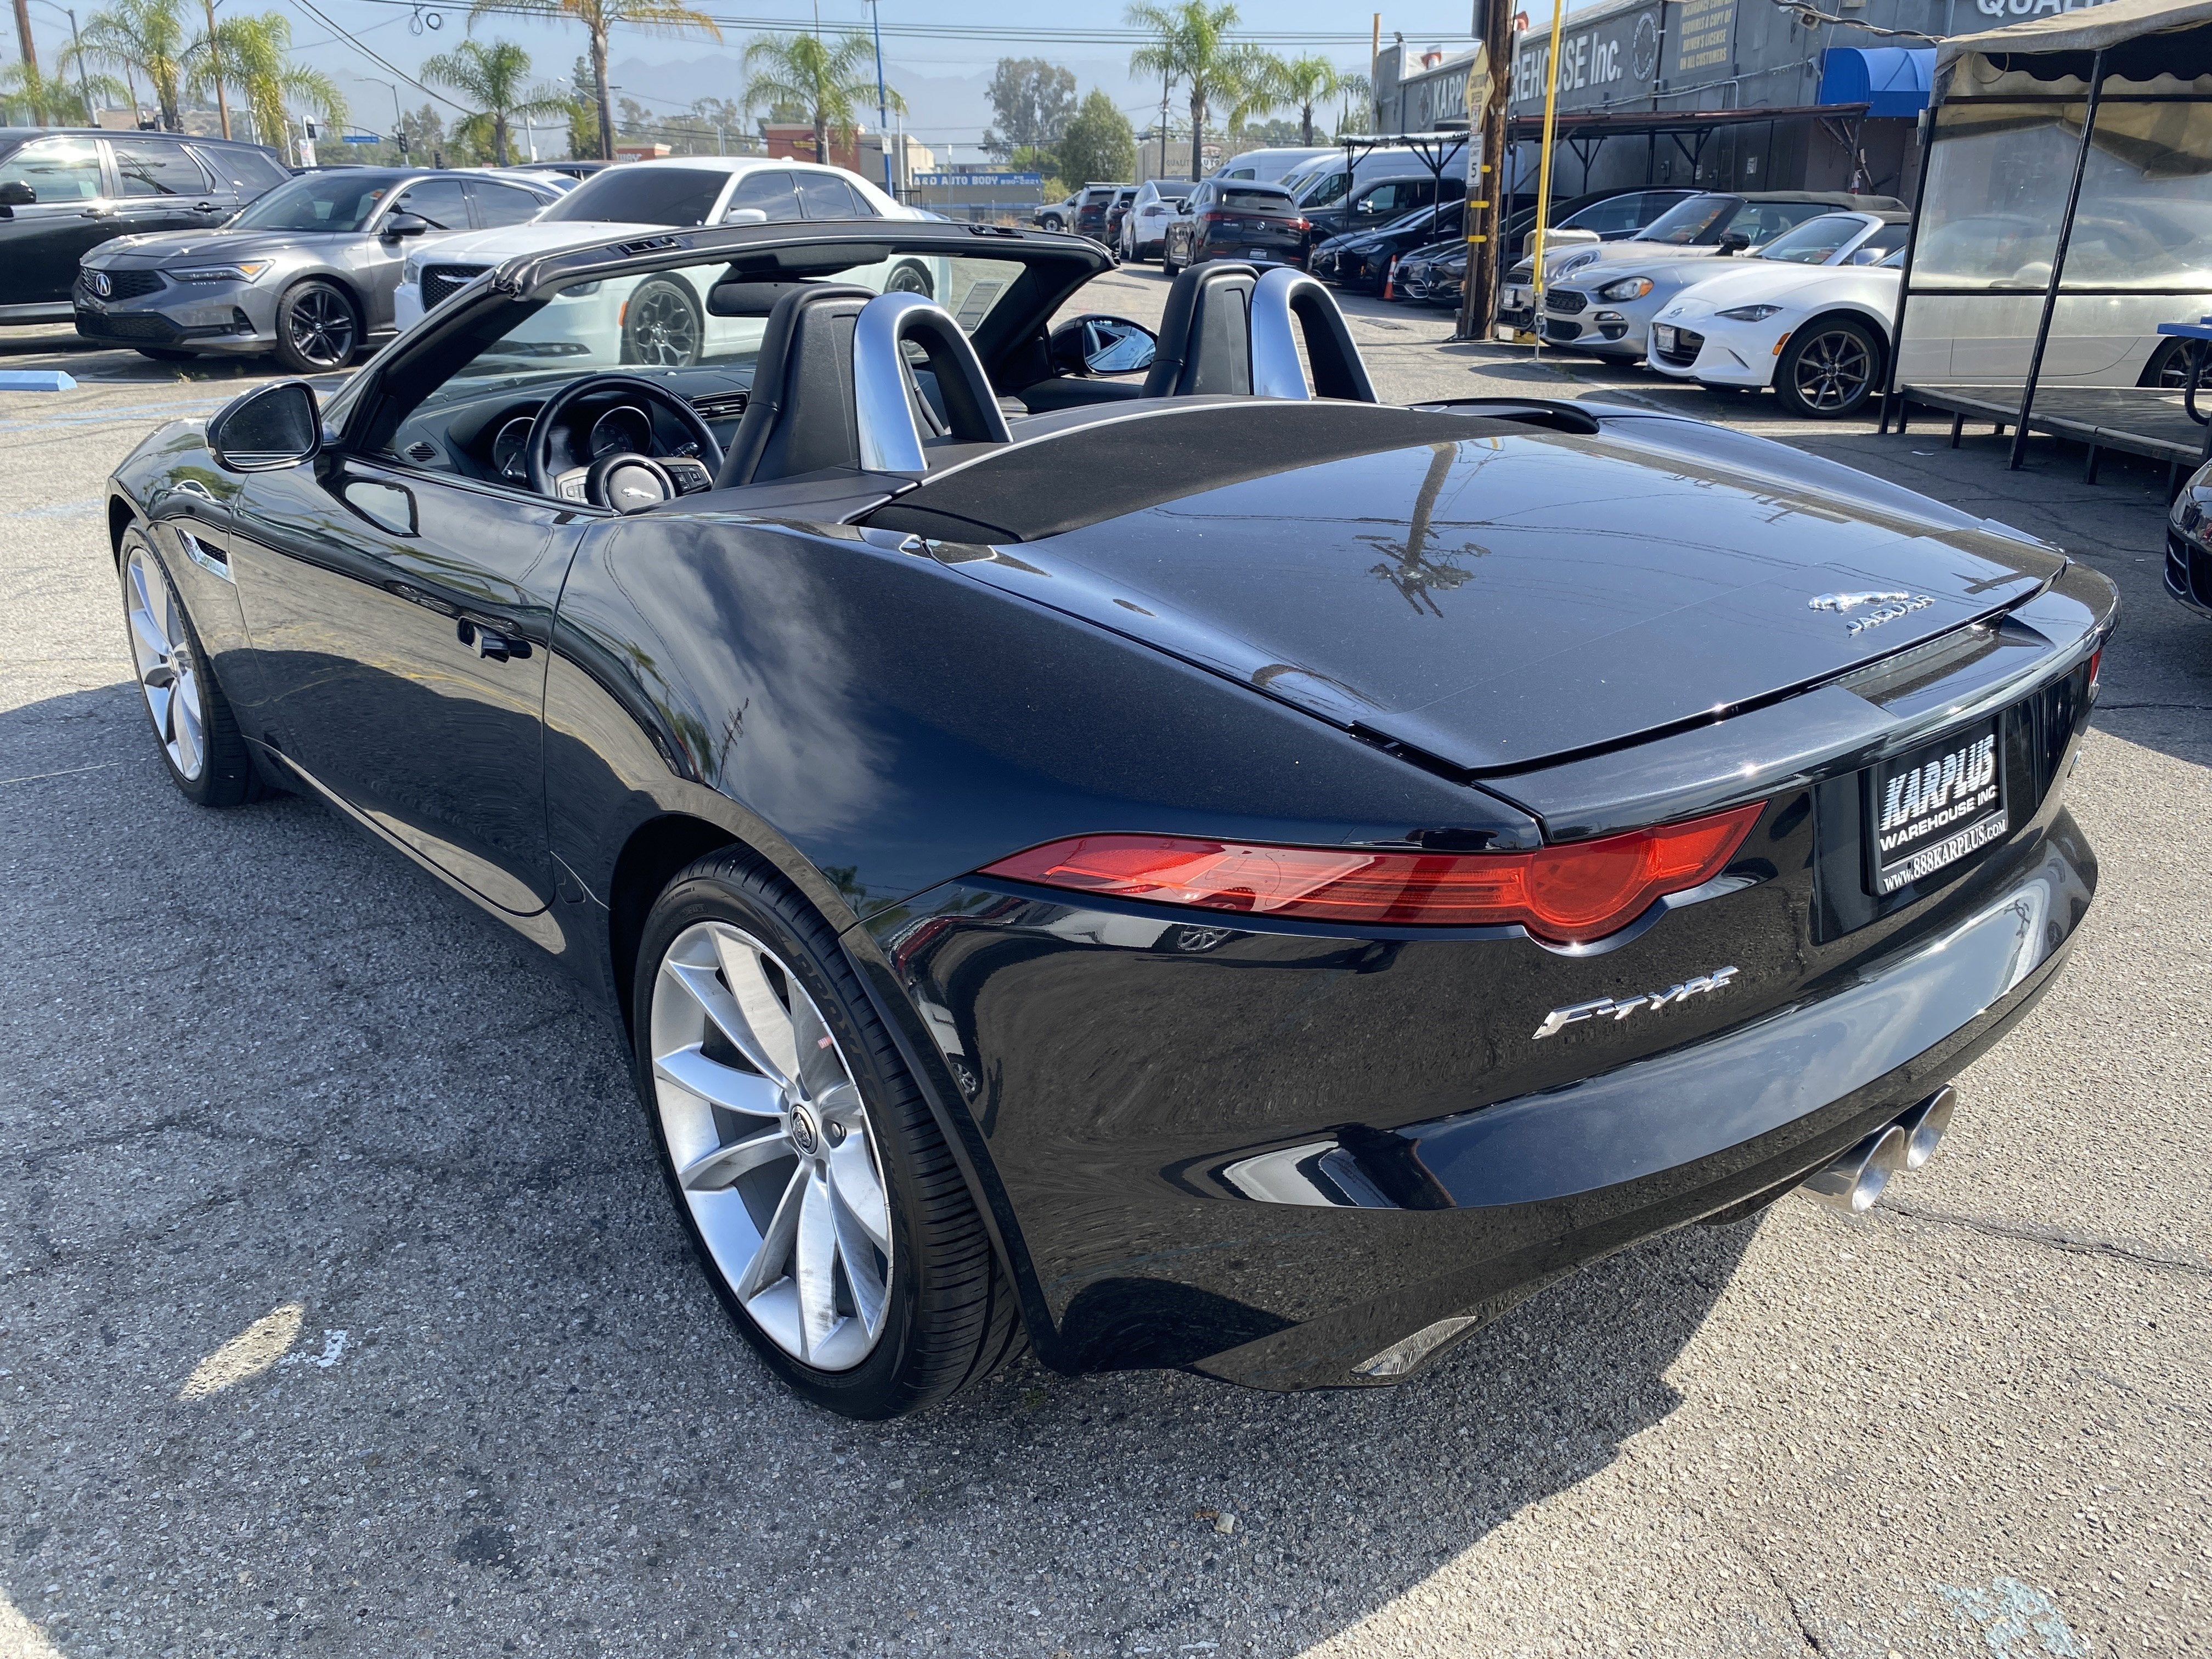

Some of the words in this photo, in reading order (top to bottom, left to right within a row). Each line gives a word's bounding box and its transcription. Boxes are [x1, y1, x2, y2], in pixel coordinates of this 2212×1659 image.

[1710, 11, 1724, 27] COPY
[1725, 9, 1732, 23] OF
[1706, 29, 1726, 46] LICENSE
[1696, 48, 1726, 66] CUSTOMERS
[1433, 73, 1468, 120] KARPL
[1590, 31, 1624, 85] Inc.
[941, 176, 968, 185] AUTO
[972, 176, 998, 185] BODY
[1471, 162, 1477, 178] 5
[1846, 595, 1936, 638] JAGUAR
[1878, 733, 1994, 831] KARPLUS
[1880, 797, 1974, 851] WAREHOUSE
[1977, 785, 1997, 806] INC
[1532, 966, 1739, 1039] F-TYPE
